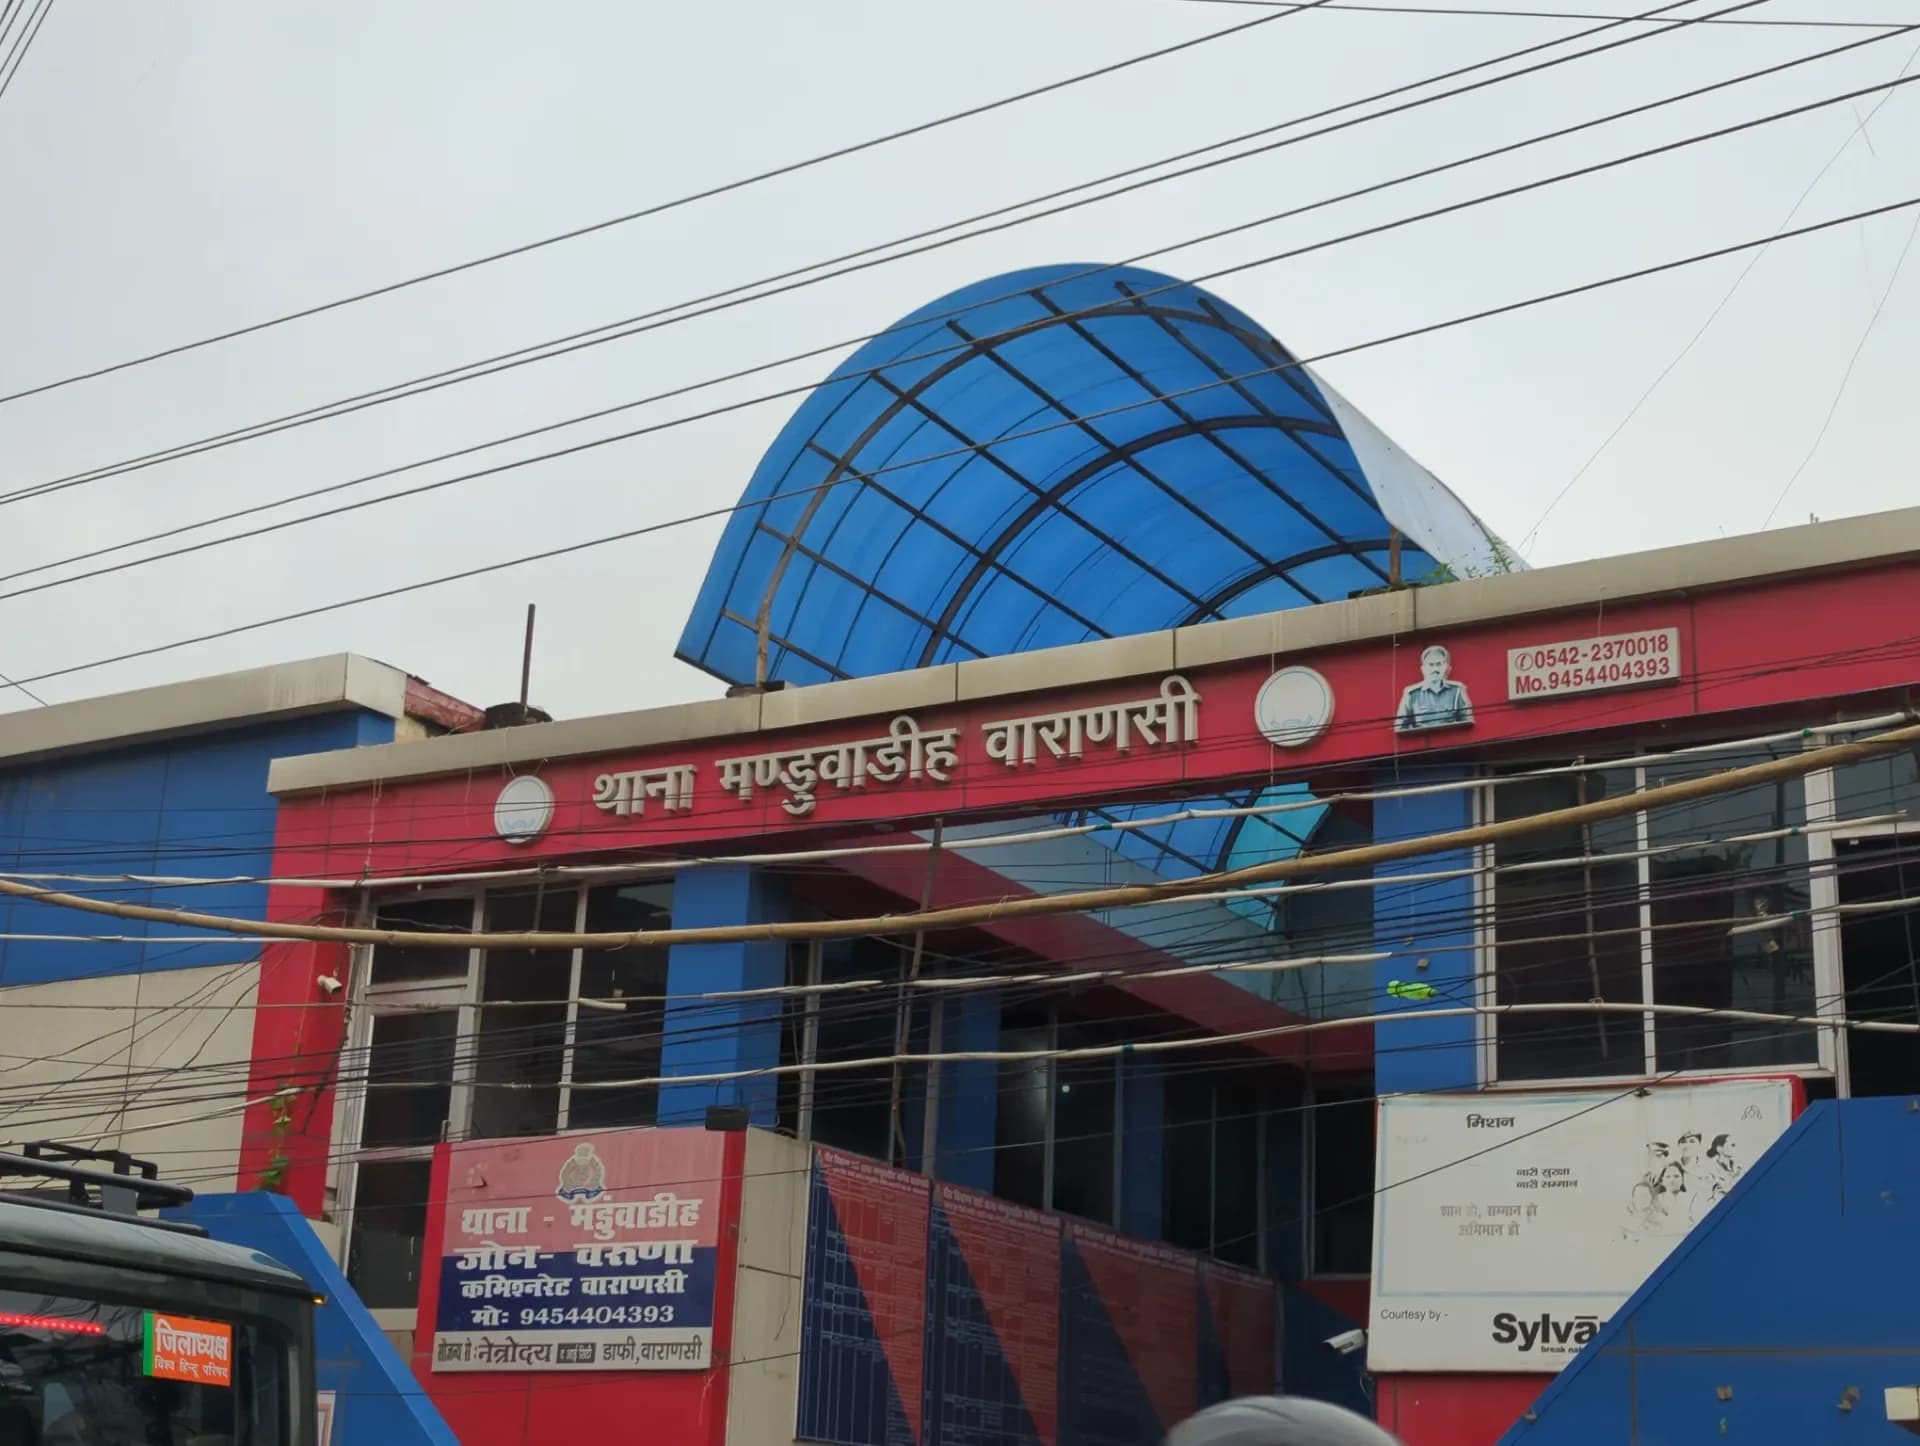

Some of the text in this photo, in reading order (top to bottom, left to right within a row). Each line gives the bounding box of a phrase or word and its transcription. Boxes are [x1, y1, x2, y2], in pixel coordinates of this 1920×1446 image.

[1534, 634, 1669, 669] 0542-2370018
[1515, 657, 1670, 694] Mo.9454404393
[593, 675, 1202, 816] थाना मण्डुवाडीह वाराणसी
[1466, 1113, 1517, 1129] मिशन
[581, 1270, 688, 1295] वाराणसी
[520, 1306, 674, 1326] 9454404393
[1381, 1309, 1426, 1321] Courtesy
[1429, 1309, 1441, 1321] by
[156, 1318, 228, 1360] जिलाध्यक्ष
